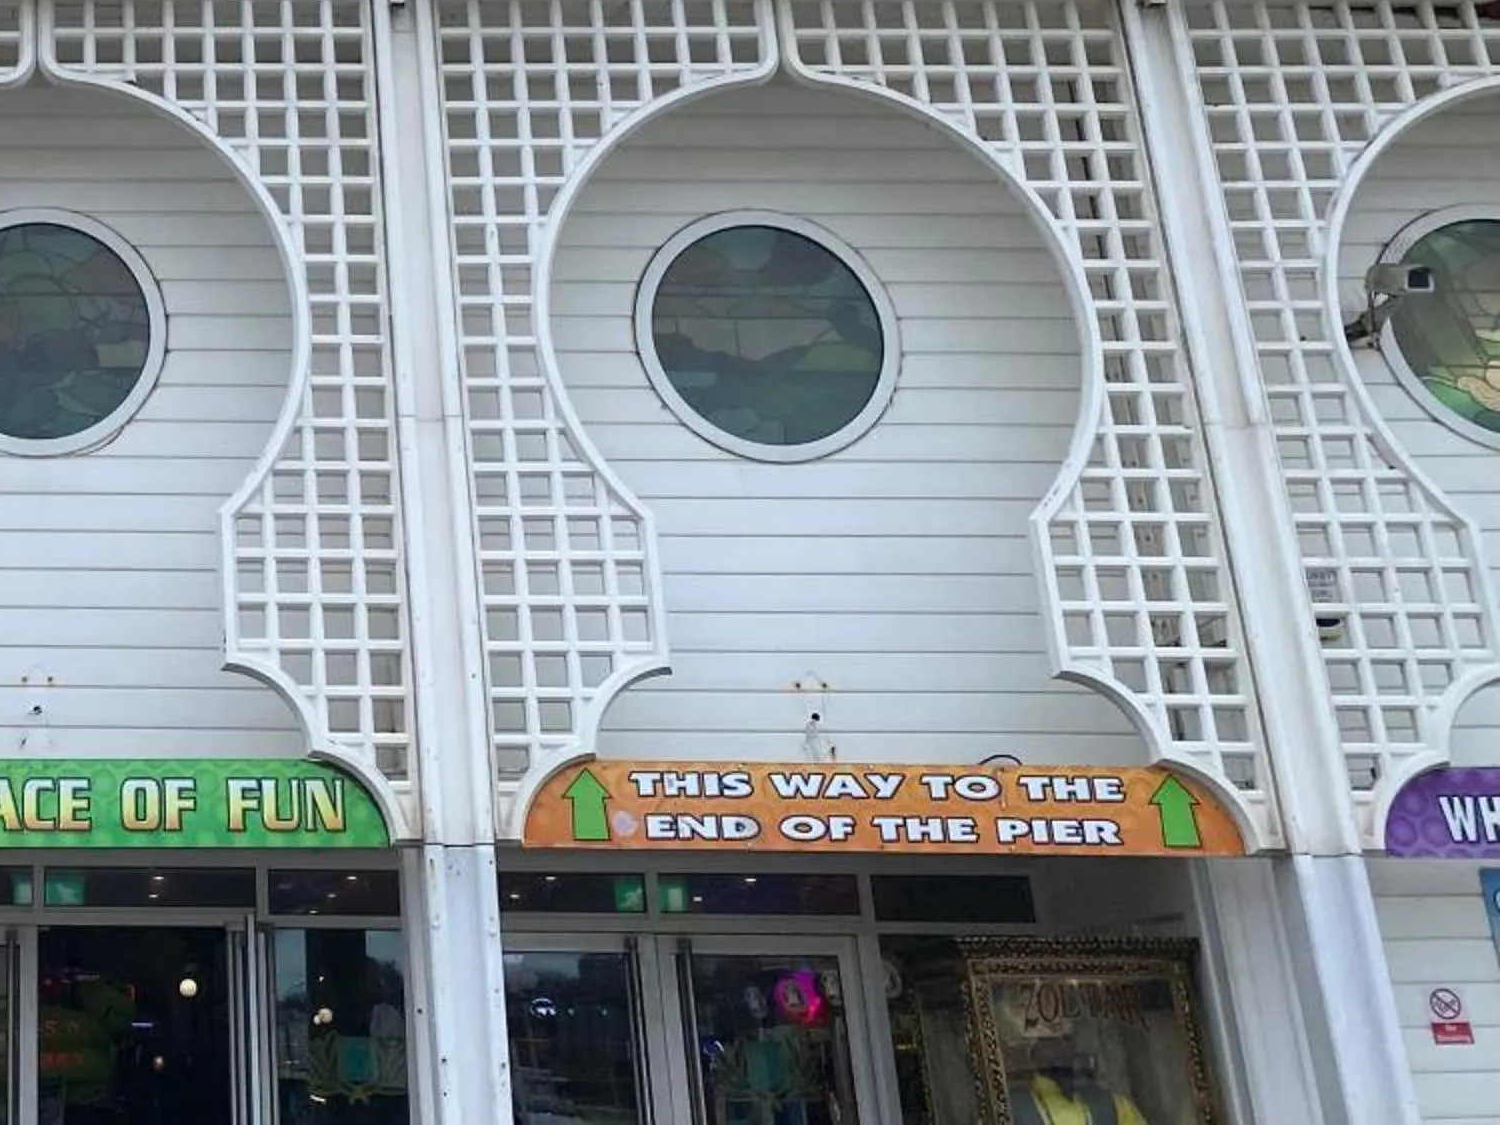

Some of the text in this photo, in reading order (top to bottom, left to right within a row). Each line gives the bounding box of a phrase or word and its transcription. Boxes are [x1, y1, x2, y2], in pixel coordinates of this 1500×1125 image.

[629, 770, 1126, 803] THIS WAY TO THE
[120, 777, 197, 832] OF
[227, 777, 346, 833] FUN
[645, 813, 1124, 845] END OF THE PIER
